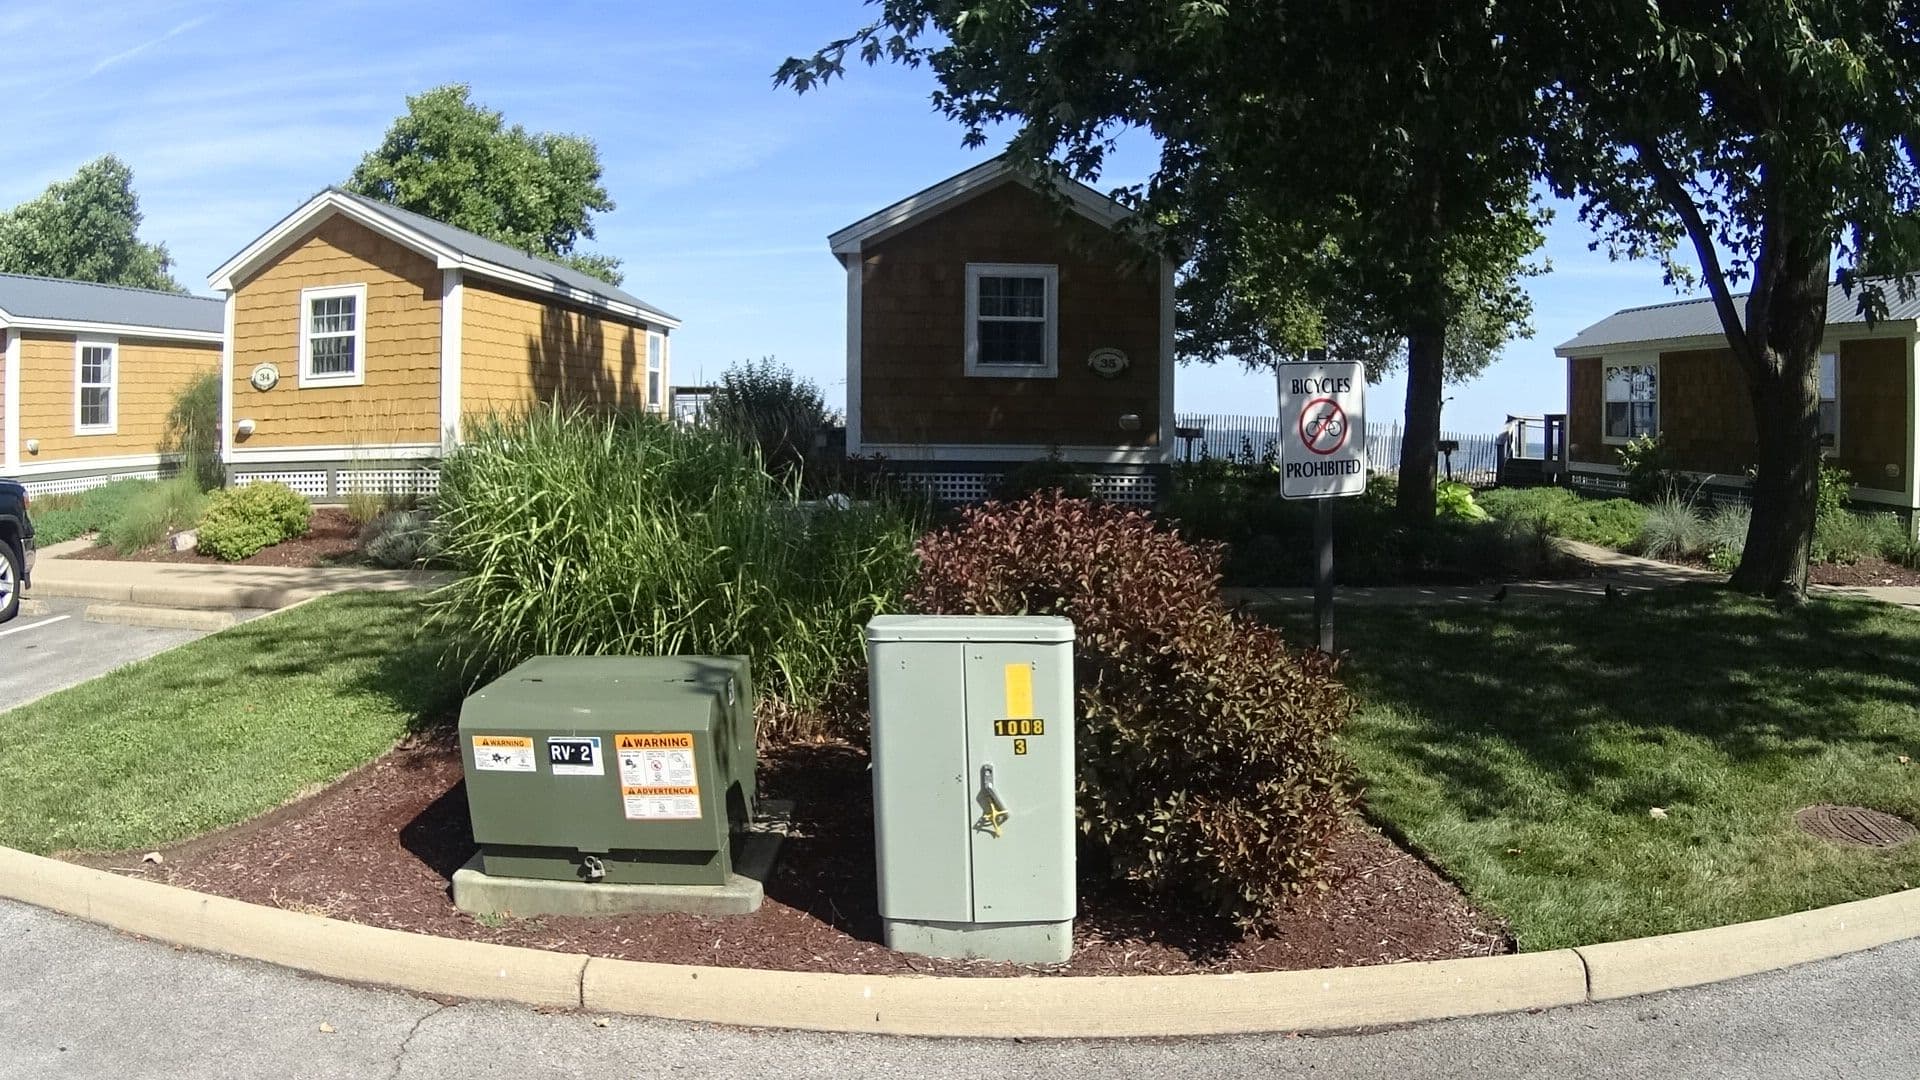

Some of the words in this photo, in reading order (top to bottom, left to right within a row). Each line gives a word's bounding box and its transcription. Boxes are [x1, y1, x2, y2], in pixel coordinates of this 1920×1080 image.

[1100, 358, 1116, 368] 35
[259, 373, 270, 381] 34
[1292, 377, 1351, 395] BICYCLES
[1286, 459, 1361, 478] PROHIBITED
[995, 720, 1043, 735] 1008
[490, 739, 524, 748] WARNING
[634, 737, 688, 748] WARNING
[1015, 739, 1025, 754] 3
[637, 787, 694, 795] ADVERTENCIA
